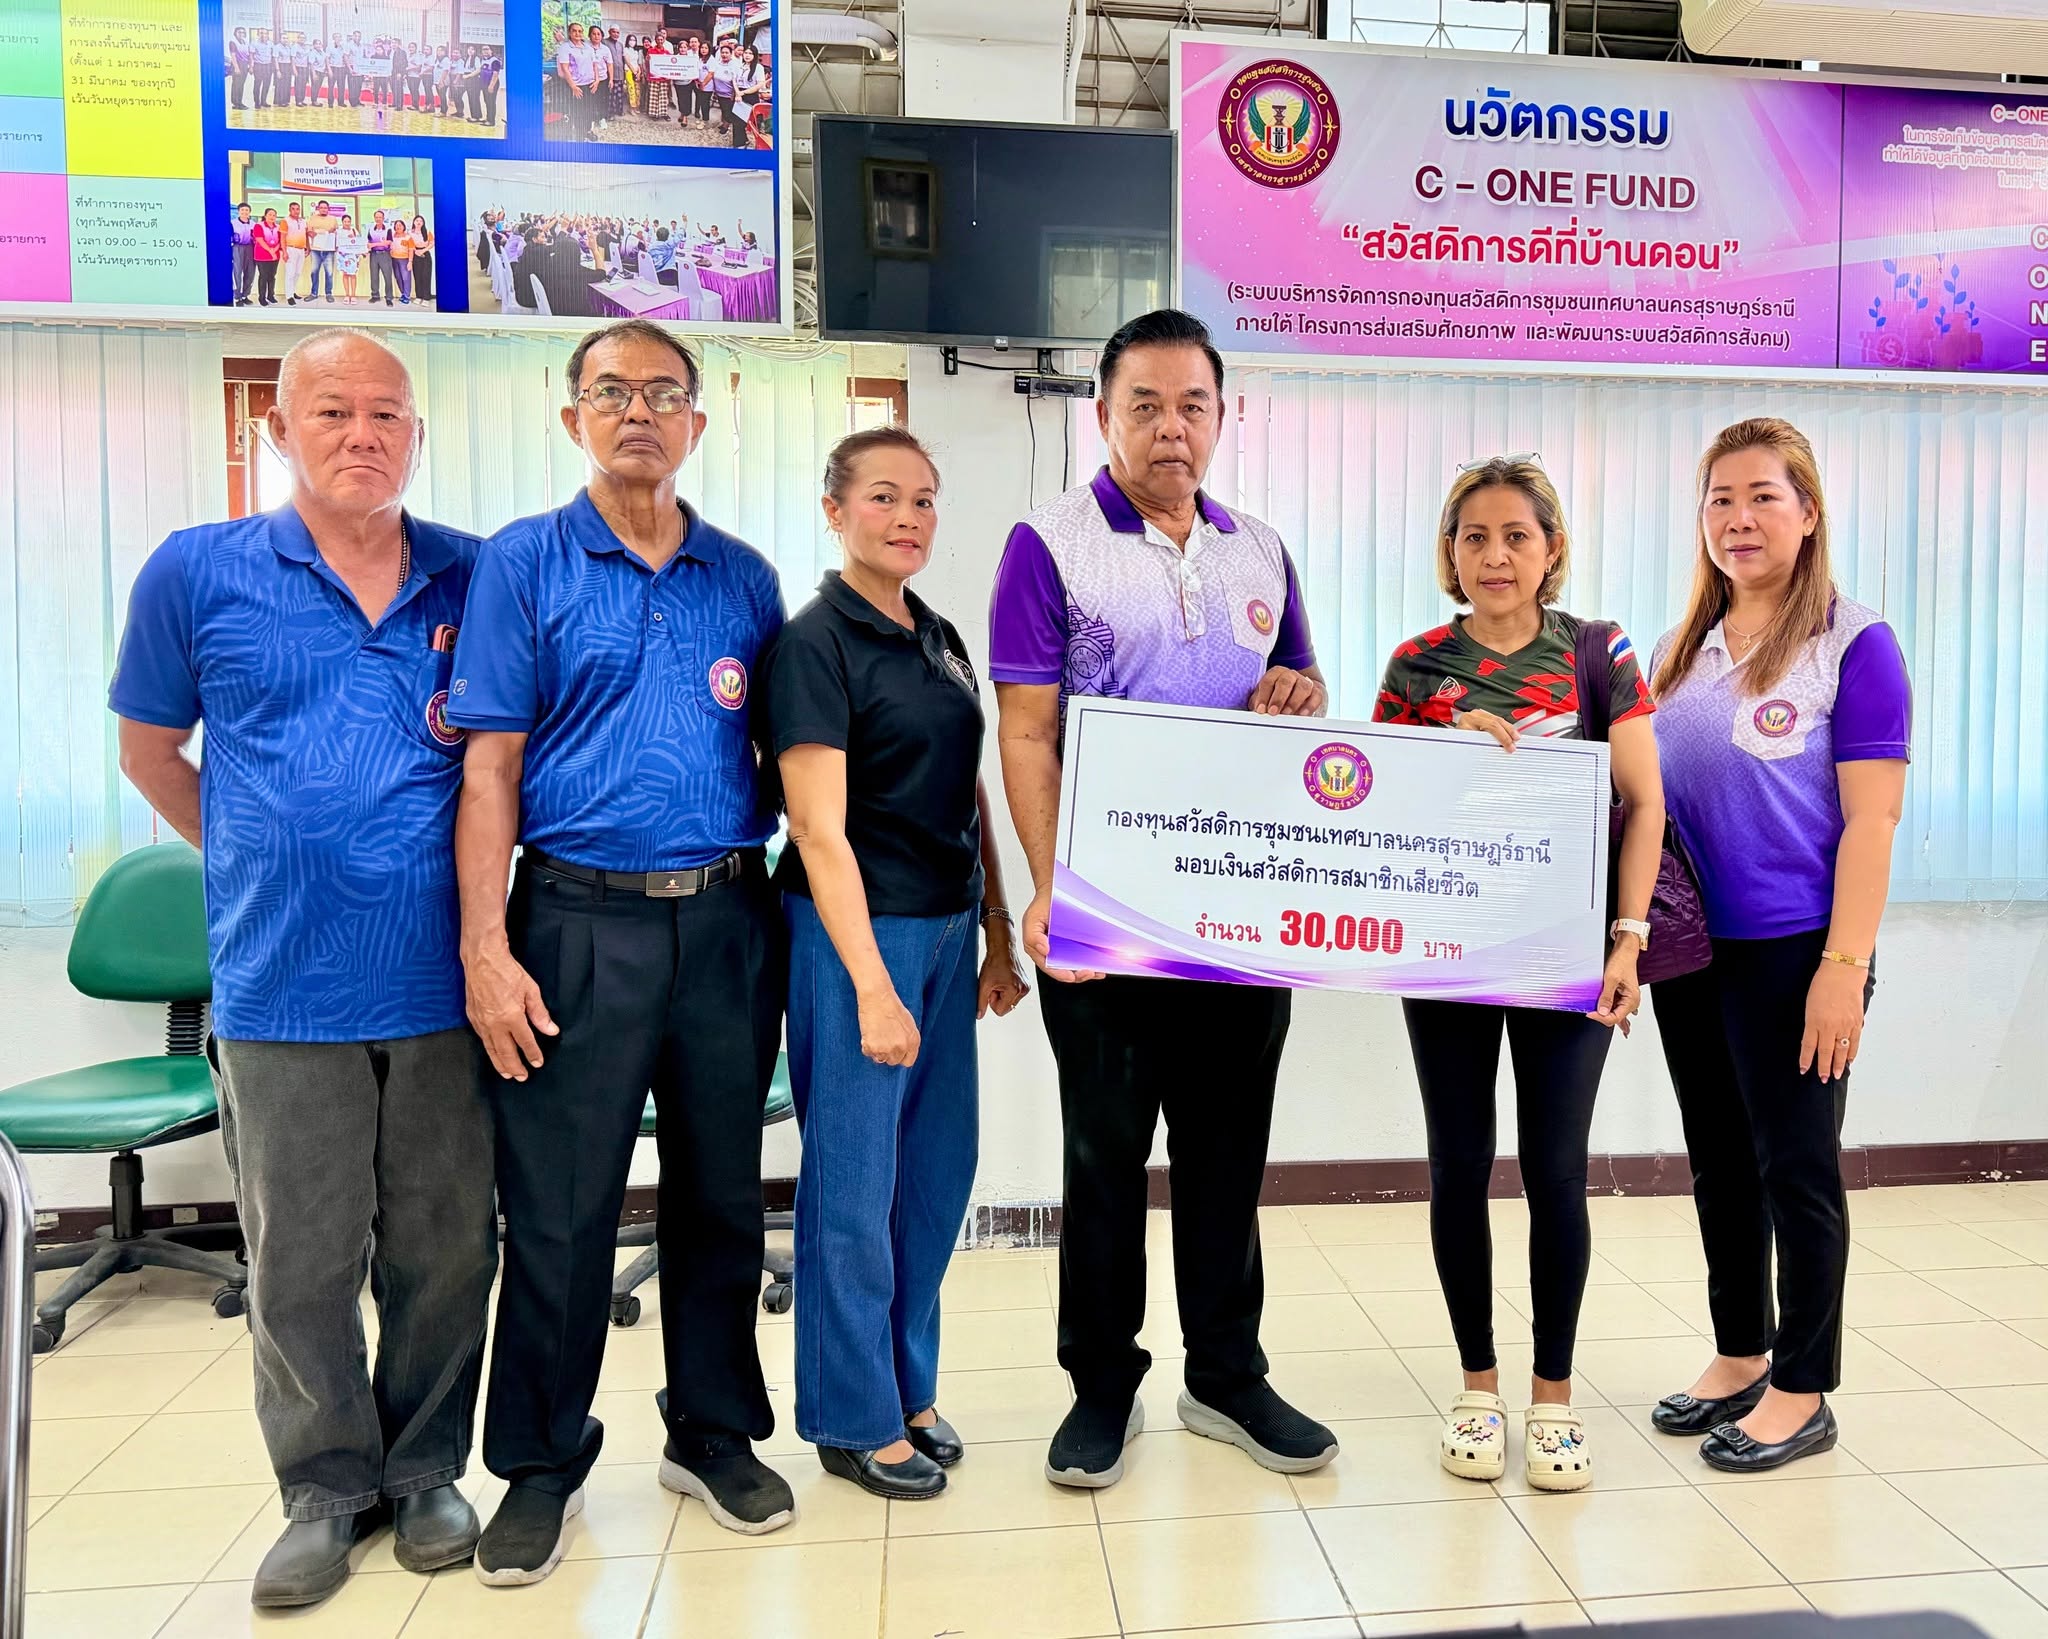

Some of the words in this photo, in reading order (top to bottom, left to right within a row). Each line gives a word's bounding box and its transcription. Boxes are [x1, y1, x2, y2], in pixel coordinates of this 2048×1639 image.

[107, 56, 113, 67] 1
[117, 58, 162, 69] มกราคม
[71, 76, 85, 86] 31
[89, 75, 127, 87] มีนาคม
[131, 78, 176, 91] ของทุกปี
[1446, 87, 1669, 146] นวัตกรรม
[1993, 107, 2004, 120] C
[1415, 165, 1445, 199] C
[1486, 168, 1572, 204] ONE
[1585, 173, 1697, 210] FUND
[75, 216, 158, 230] (ทุกวันพฤหัสบดี
[77, 236, 101, 247] เวลา
[104, 236, 136, 247] 09.00
[152, 238, 183, 248] 15.00
[1227, 281, 1795, 320] (ระบบบริหารจัดการกองทุนสวัสดิการชุมชนเทศบาลนครสุราษฎร์ธานี
[1235, 312, 1292, 334] ภายใต้
[1298, 313, 1516, 341] โครงการส่งเสริมศักยภาพ
[1526, 322, 1791, 351] และพัฒนาระบบสวัสดิการสังคม)
[1107, 807, 1552, 867] กองทุนสวัสดิการชุมชนเทศบาลนครสุราษฎร์ธานี
[1174, 852, 1480, 898] มอบเงินสวัสดิการสมาชิกเสียชีวิต
[1194, 913, 1262, 944] จำนวน
[1279, 909, 1404, 956] 30,000
[1423, 939, 1463, 961] บาท
